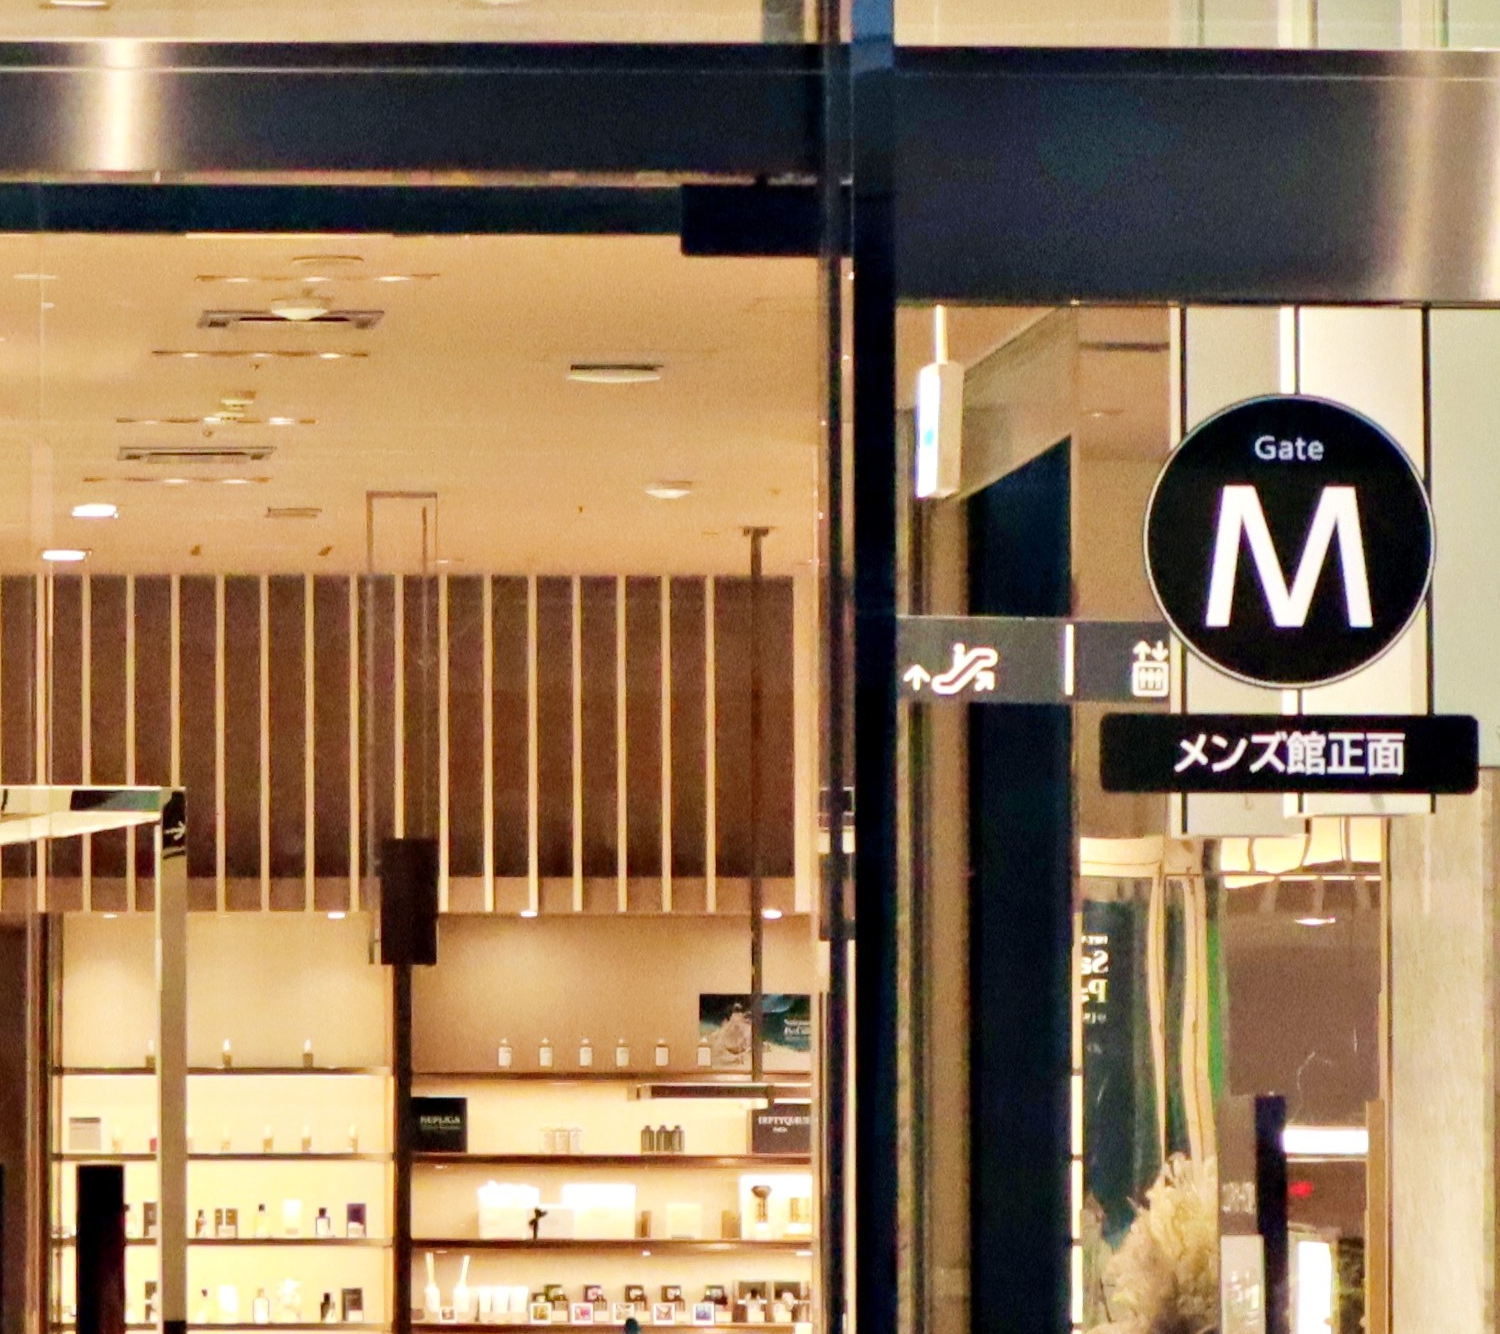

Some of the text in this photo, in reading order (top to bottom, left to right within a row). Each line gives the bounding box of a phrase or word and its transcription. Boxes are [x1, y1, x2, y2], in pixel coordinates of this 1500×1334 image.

[1254, 435, 1325, 462] Gate
[1205, 485, 1374, 627] M
[1173, 733, 1405, 776] メンズ館正面
